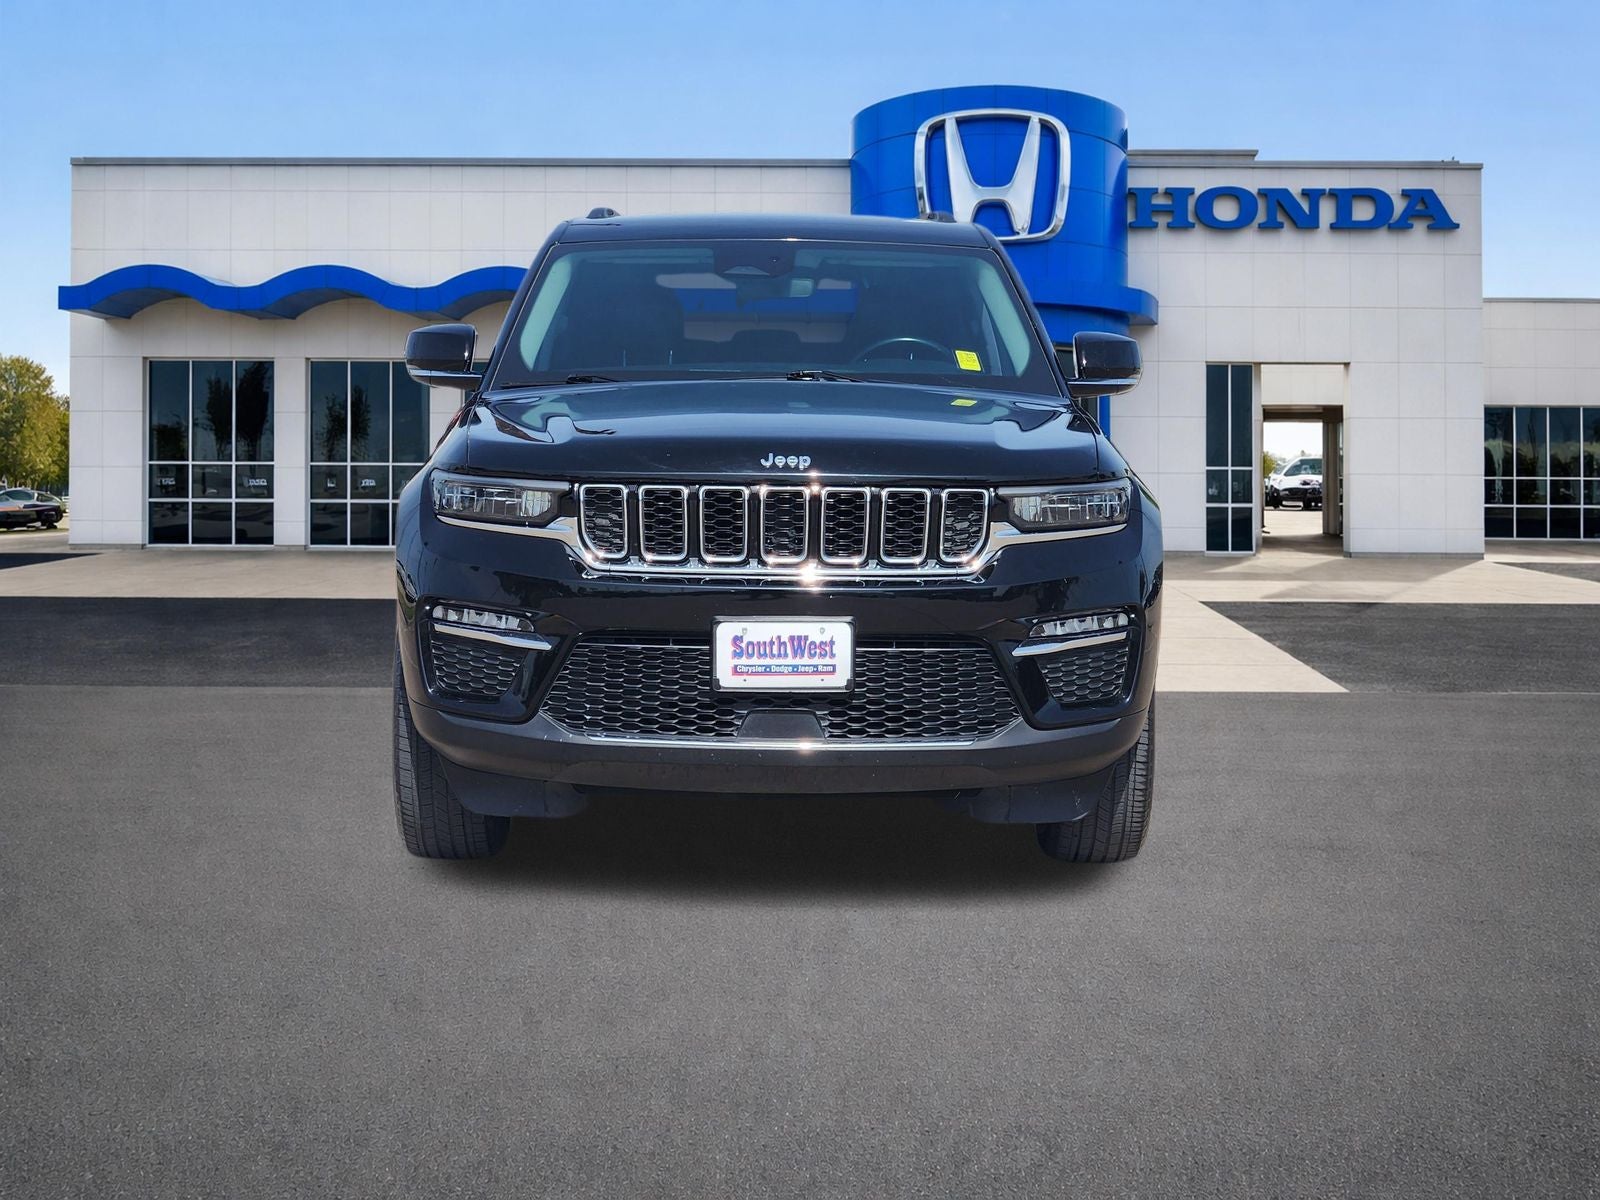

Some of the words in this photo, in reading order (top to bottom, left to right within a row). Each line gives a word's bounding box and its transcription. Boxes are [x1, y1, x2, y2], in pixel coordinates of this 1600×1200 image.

[1127, 185, 1460, 230] HONDA
[760, 452, 811, 470] Jeep
[731, 635, 836, 660] SouthWest
[736, 665, 766, 674] Chrysler
[771, 665, 793, 674] Dodge
[797, 665, 814, 673] Jeep
[818, 665, 834, 673] Ram
